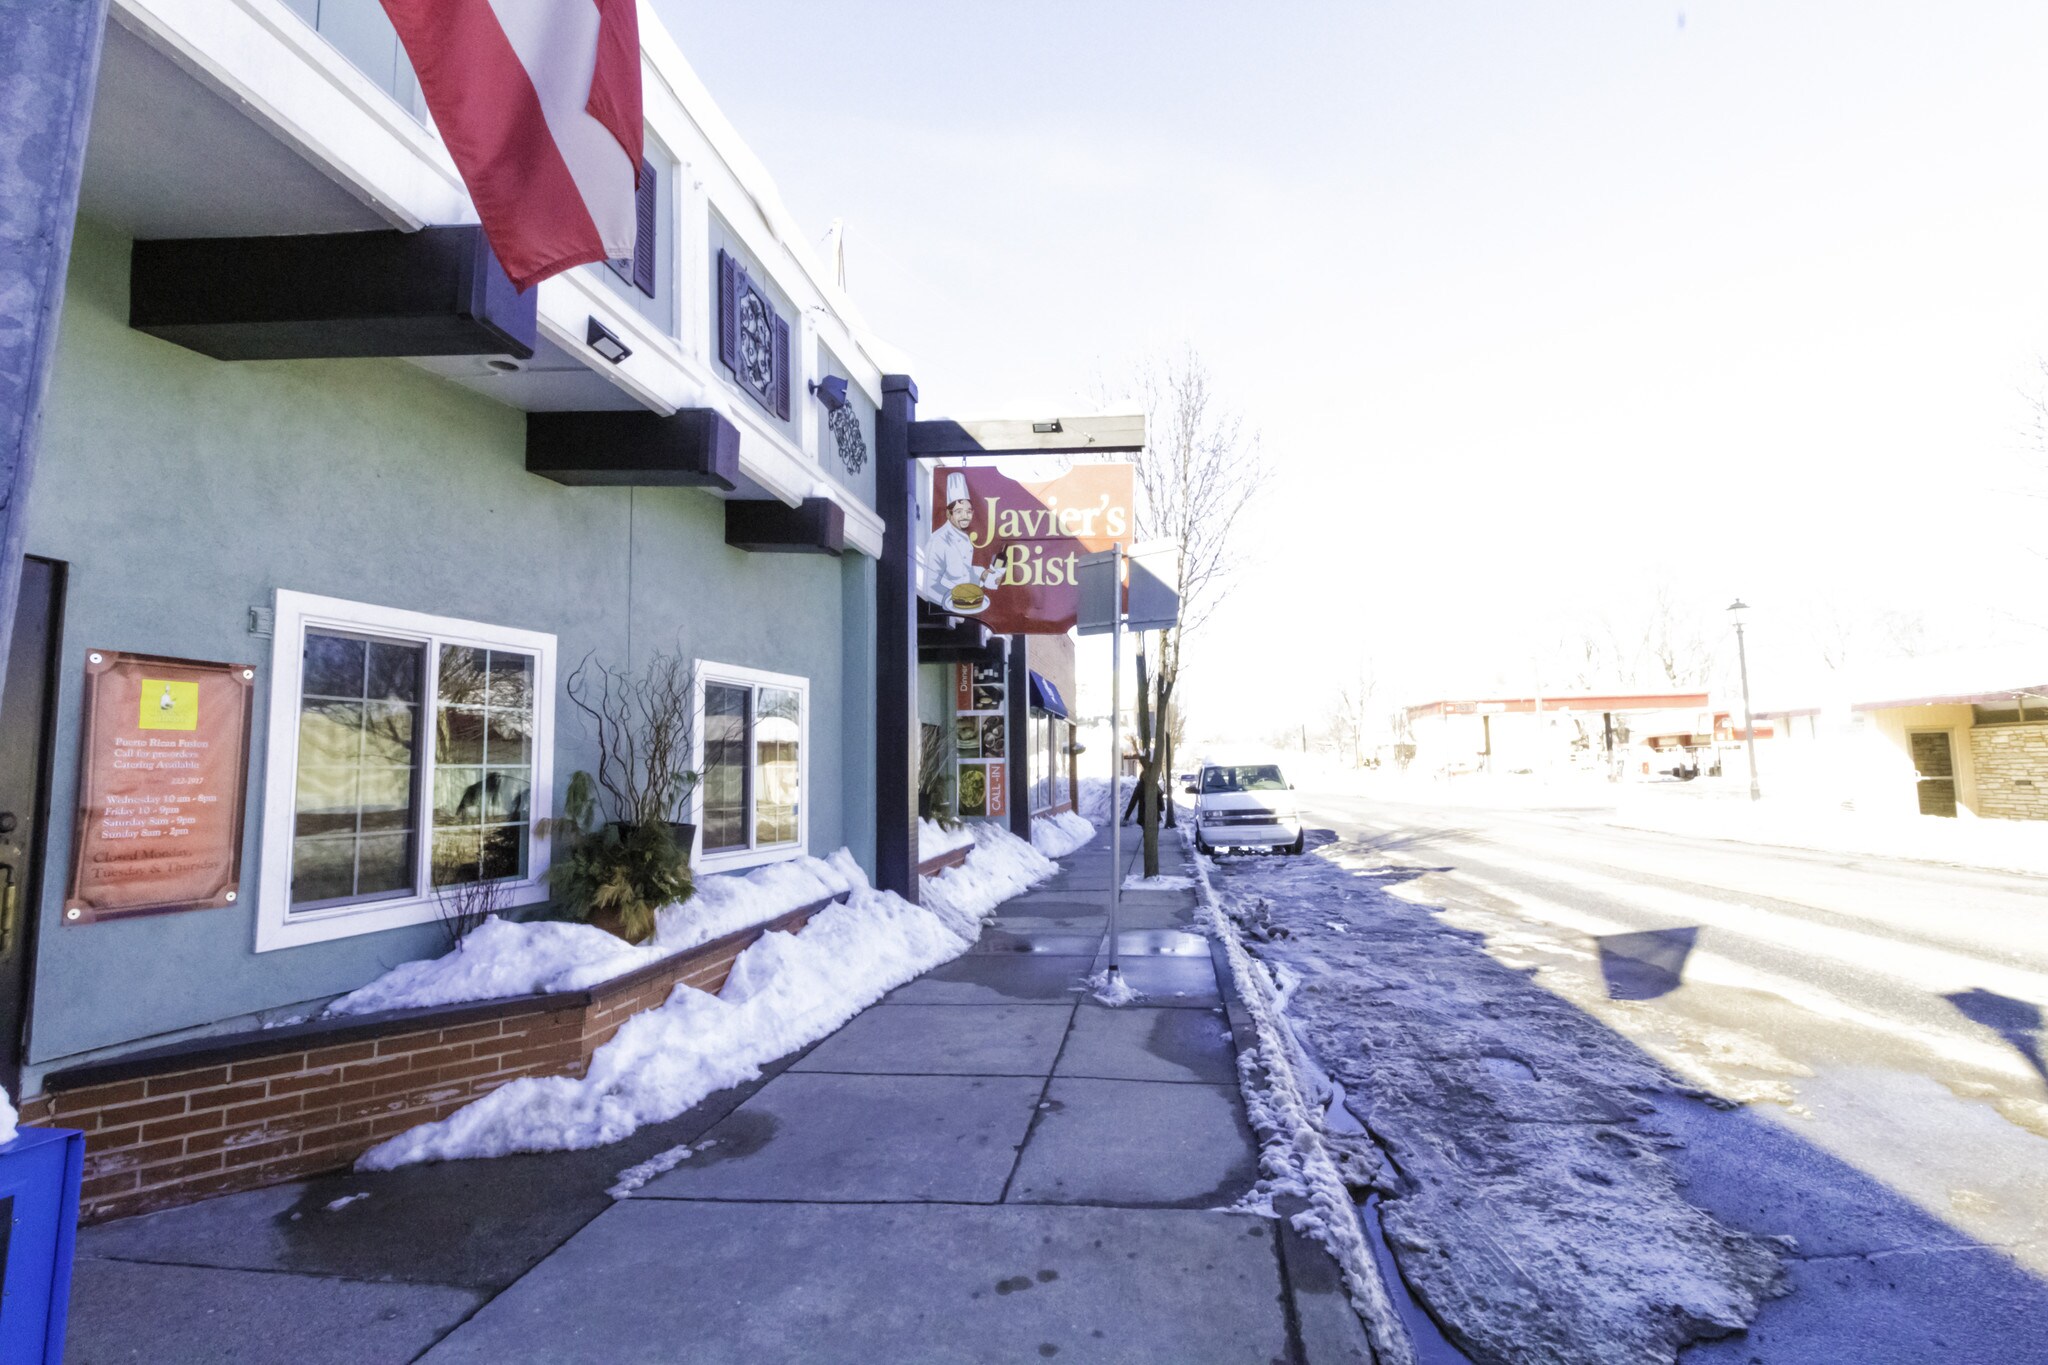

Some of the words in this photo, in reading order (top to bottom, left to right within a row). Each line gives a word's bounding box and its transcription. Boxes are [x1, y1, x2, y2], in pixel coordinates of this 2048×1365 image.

[970, 494, 1126, 548] Javier's
[1001, 545, 1127, 586] Bist
[960, 664, 968, 692] Dinner
[115, 737, 148, 747] Puerto
[149, 738, 177, 747] Rican
[179, 739, 208, 748] Fusion
[114, 748, 133, 758] Call
[136, 749, 151, 758] for
[113, 760, 153, 770] Catering
[157, 761, 200, 769] Available
[107, 795, 160, 805] Wednesday
[164, 795, 176, 803] 10
[104, 807, 134, 817] Friday
[160, 805, 179, 815] 9pm
[102, 818, 145, 828] Saturday
[177, 816, 196, 825] 9pm
[102, 831, 138, 839] Sunday
[170, 827, 188, 837] 2pm
[93, 850, 137, 863] Closed
[91, 866, 144, 878] Tuesday
[167, 859, 220, 872] Thursday
